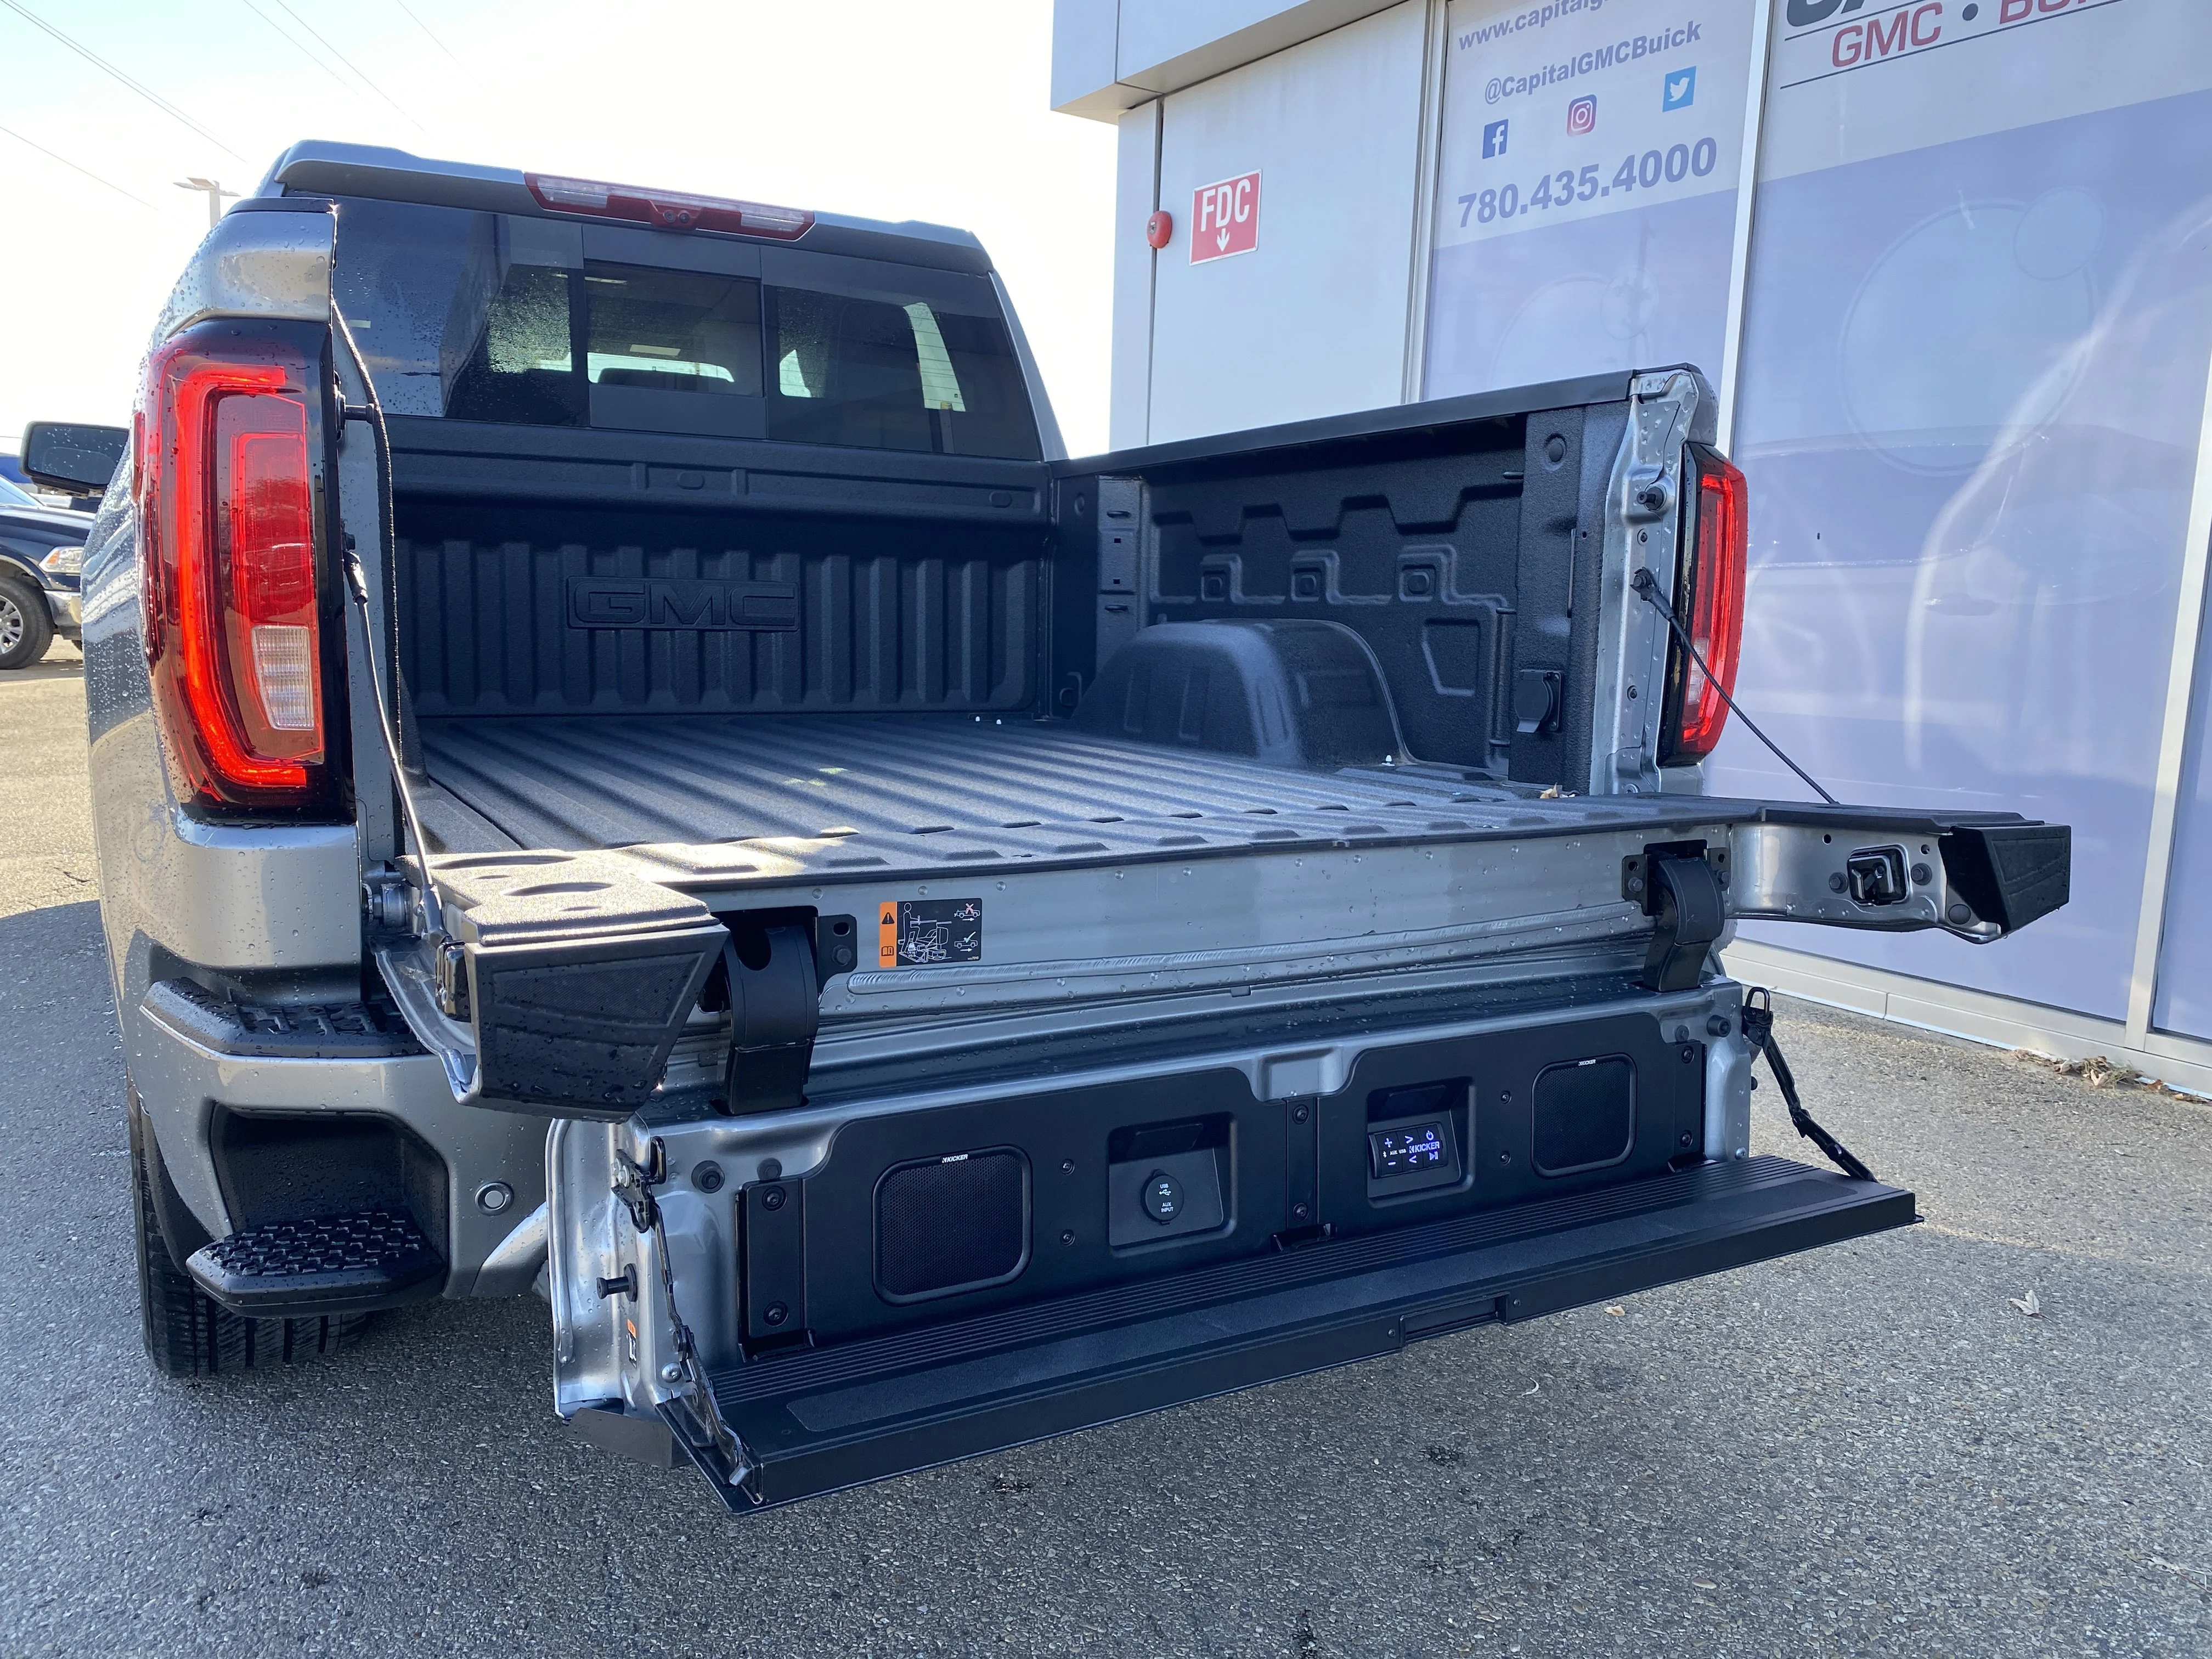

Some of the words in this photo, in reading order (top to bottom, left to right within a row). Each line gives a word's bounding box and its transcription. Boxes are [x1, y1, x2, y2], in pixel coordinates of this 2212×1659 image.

[1832, 2, 1943, 67] GMC
[1485, 20, 1702, 104] @CapitalGMCBuick
[1200, 178, 1251, 232] FDC
[1457, 137, 1717, 228] 780.435.4000
[574, 582, 795, 627] GMC
[946, 1154, 968, 1163] KICKER
[1415, 1141, 1440, 1153] KICKER
